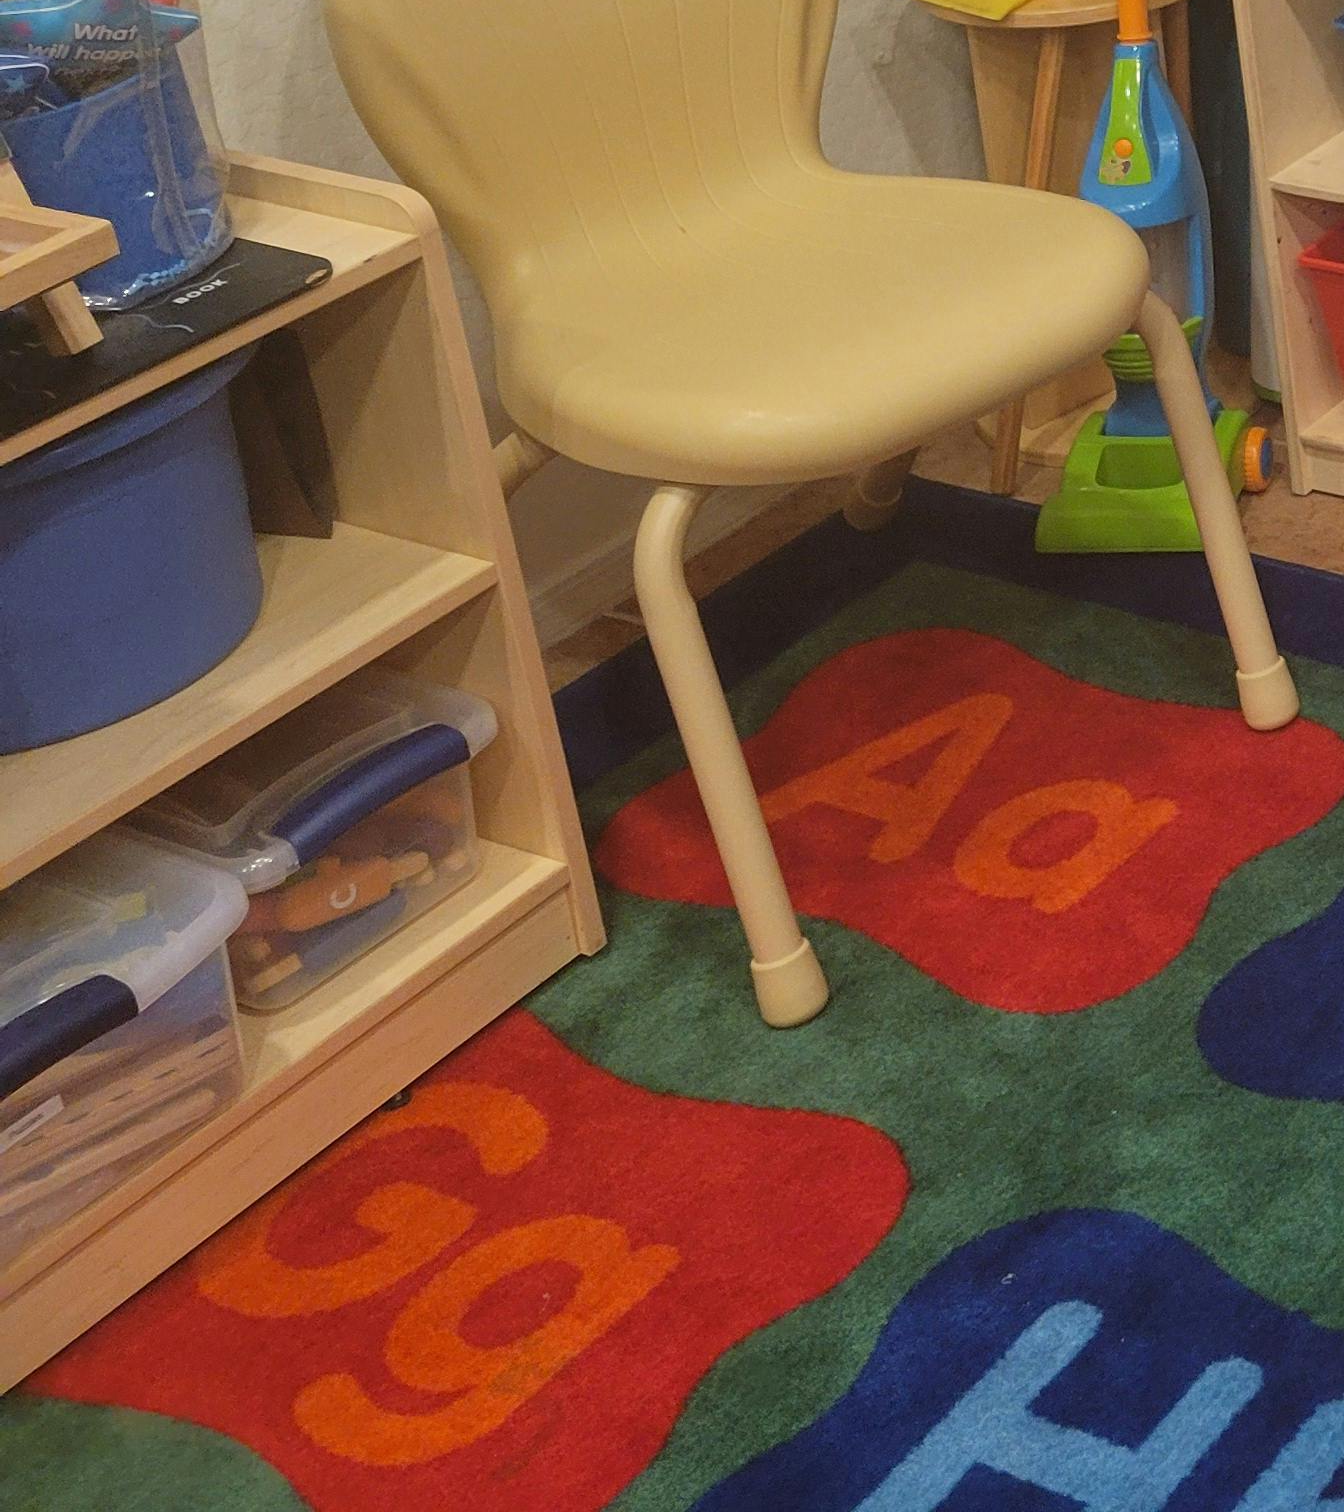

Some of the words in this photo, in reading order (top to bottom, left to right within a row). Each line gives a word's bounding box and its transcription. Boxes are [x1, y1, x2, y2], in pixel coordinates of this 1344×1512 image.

[28, 43, 70, 60] will
[74, 45, 160, 62] happ
[74, 23, 138, 41] What
[758, 693, 1181, 914] Aa
[199, 1081, 681, 1466] Gg
